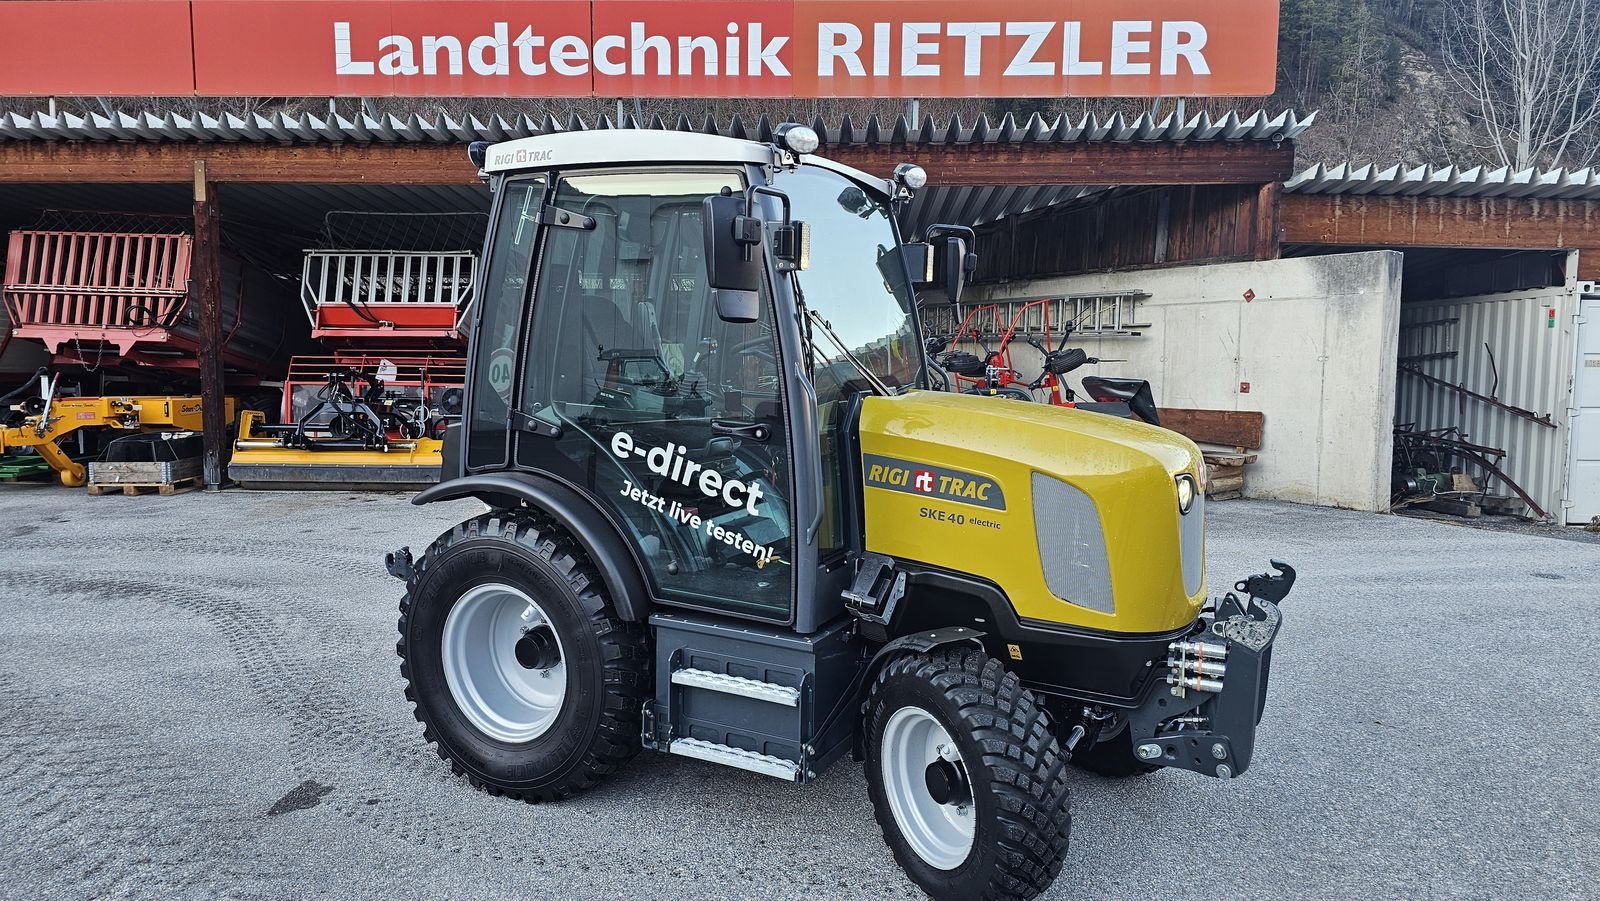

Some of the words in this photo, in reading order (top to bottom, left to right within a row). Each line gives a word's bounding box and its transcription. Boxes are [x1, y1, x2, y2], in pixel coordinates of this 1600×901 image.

[334, 22, 791, 76] Landtechnik
[818, 21, 1211, 76] RIETZLER
[495, 153, 514, 165] RIGI
[528, 150, 552, 161] TRAC
[611, 431, 763, 516] e-direct
[869, 464, 910, 486] RIGI
[939, 476, 992, 500] TRAC
[620, 480, 666, 513] Jetzt
[669, 501, 701, 529] live
[706, 520, 774, 563] testen!
[919, 507, 945, 521] SKE
[948, 513, 965, 525] 40
[969, 517, 1001, 530] electric
